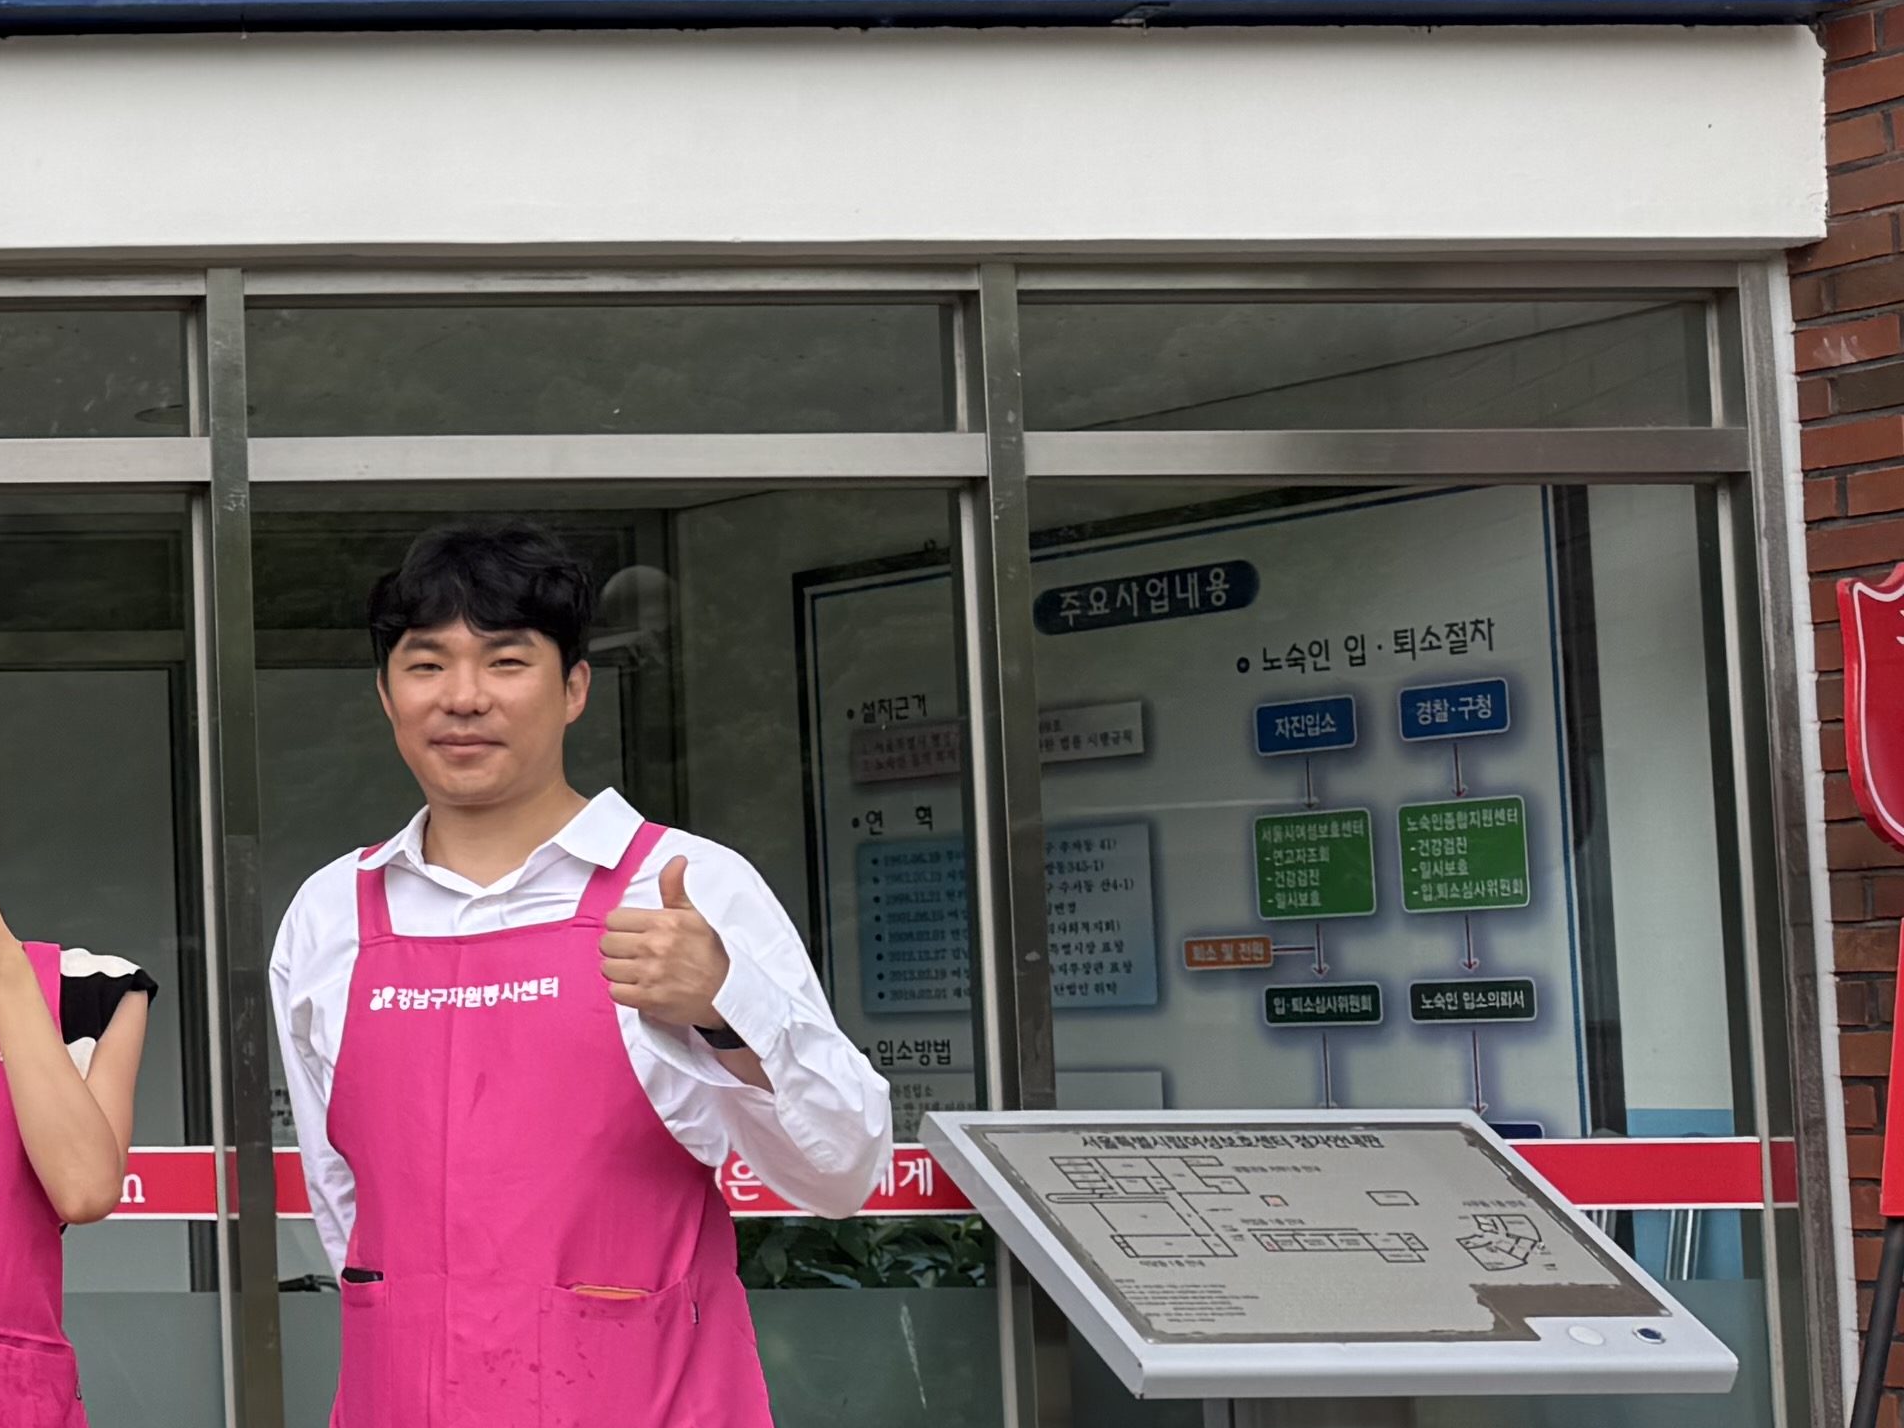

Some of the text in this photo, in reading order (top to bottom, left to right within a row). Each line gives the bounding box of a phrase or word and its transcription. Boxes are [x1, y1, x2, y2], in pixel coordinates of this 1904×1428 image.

[1058, 567, 1229, 627] 주요사업내용
[1261, 640, 1331, 674] 노숙인
[1275, 713, 1336, 739] 자진입소
[397, 976, 560, 1010] 강남구자원봉사센터
[1421, 991, 1458, 1010] 노숙인
[876, 1039, 951, 1066] 입소방법
